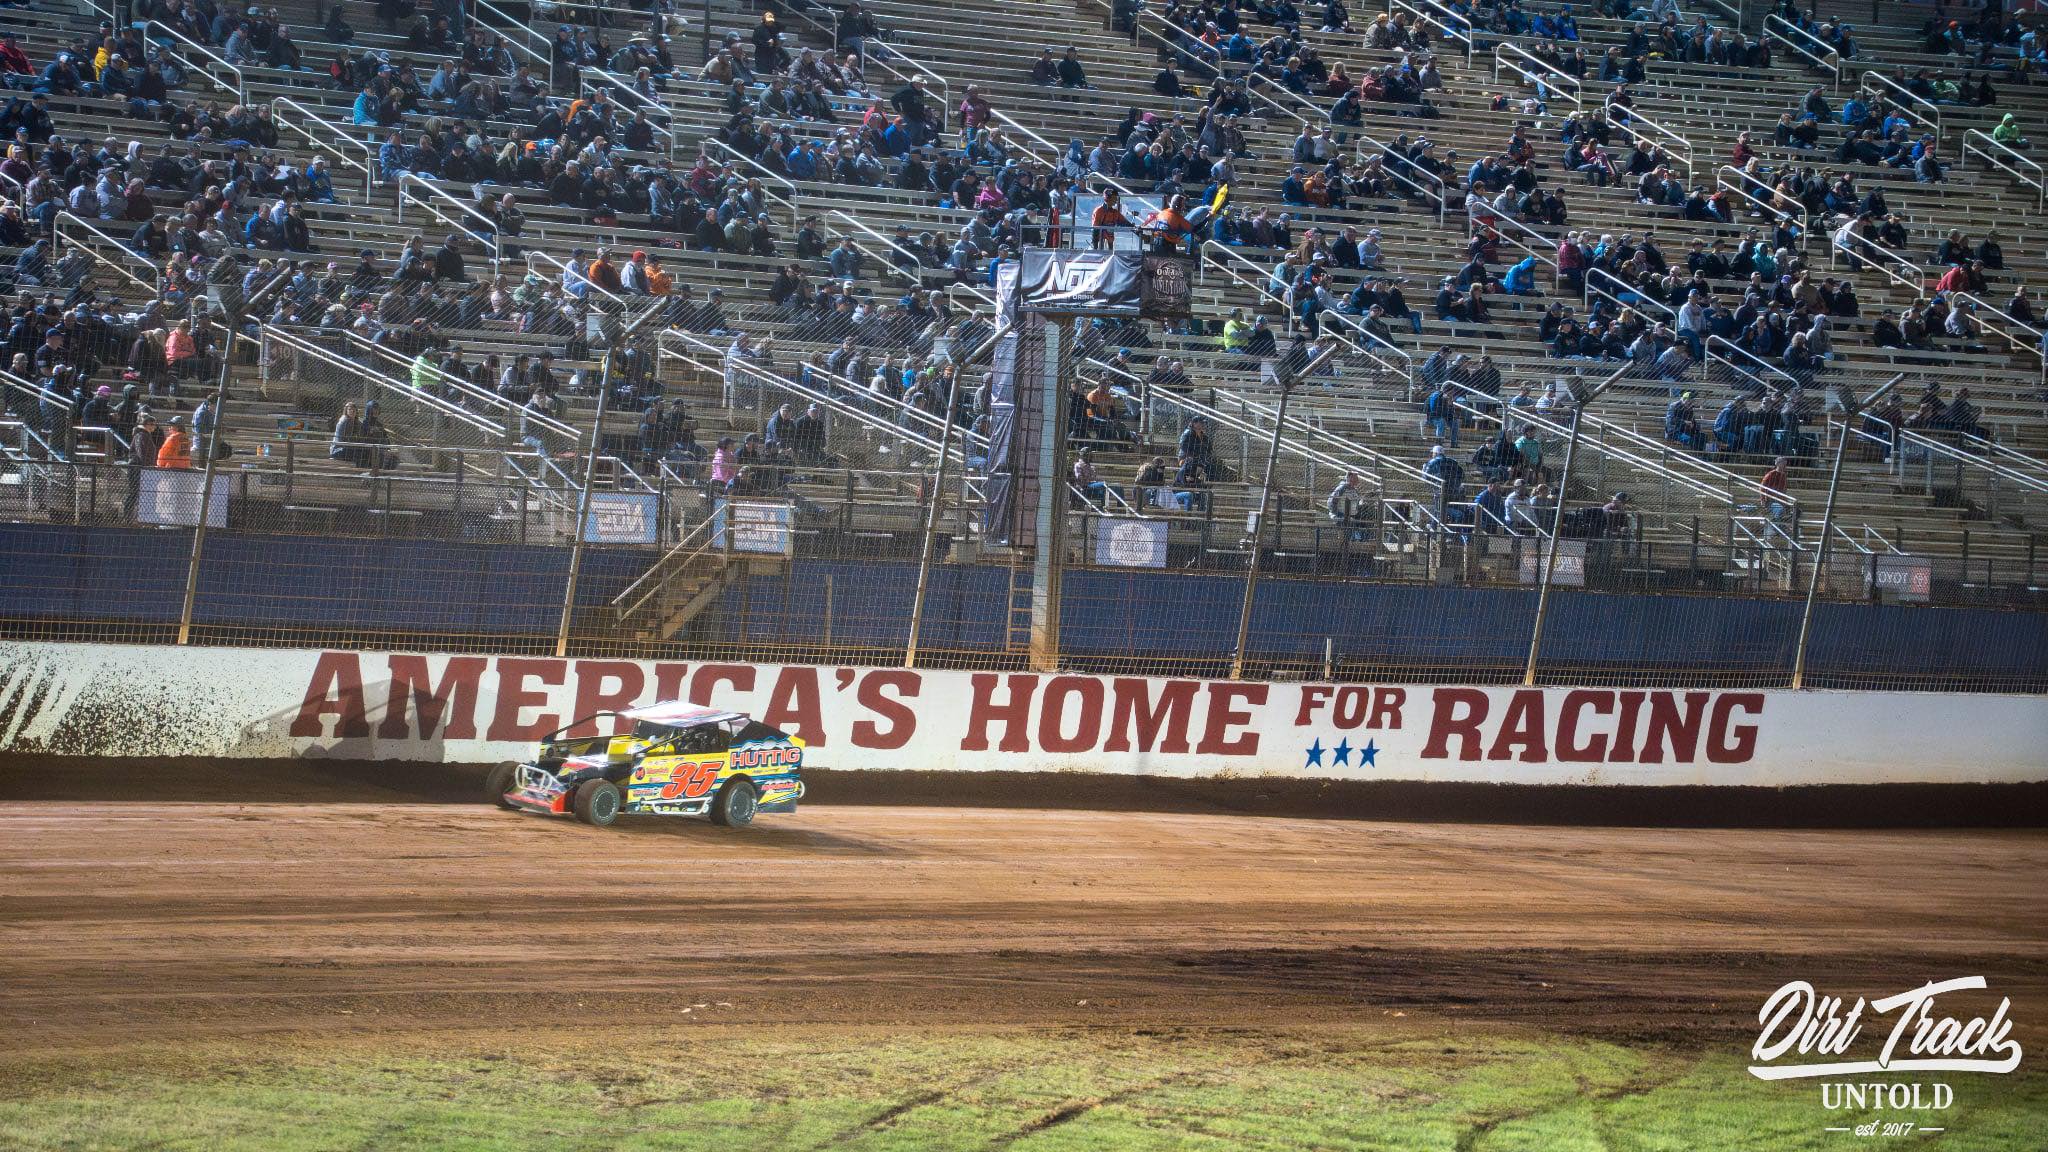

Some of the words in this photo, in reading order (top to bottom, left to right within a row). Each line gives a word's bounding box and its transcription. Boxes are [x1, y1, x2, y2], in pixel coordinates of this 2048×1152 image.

[961, 674, 1269, 755] HOME
[1295, 686, 1407, 729] FOR
[1420, 688, 1765, 763] RACING
[731, 748, 801, 768] HUTTIG
[660, 761, 724, 800] 35
